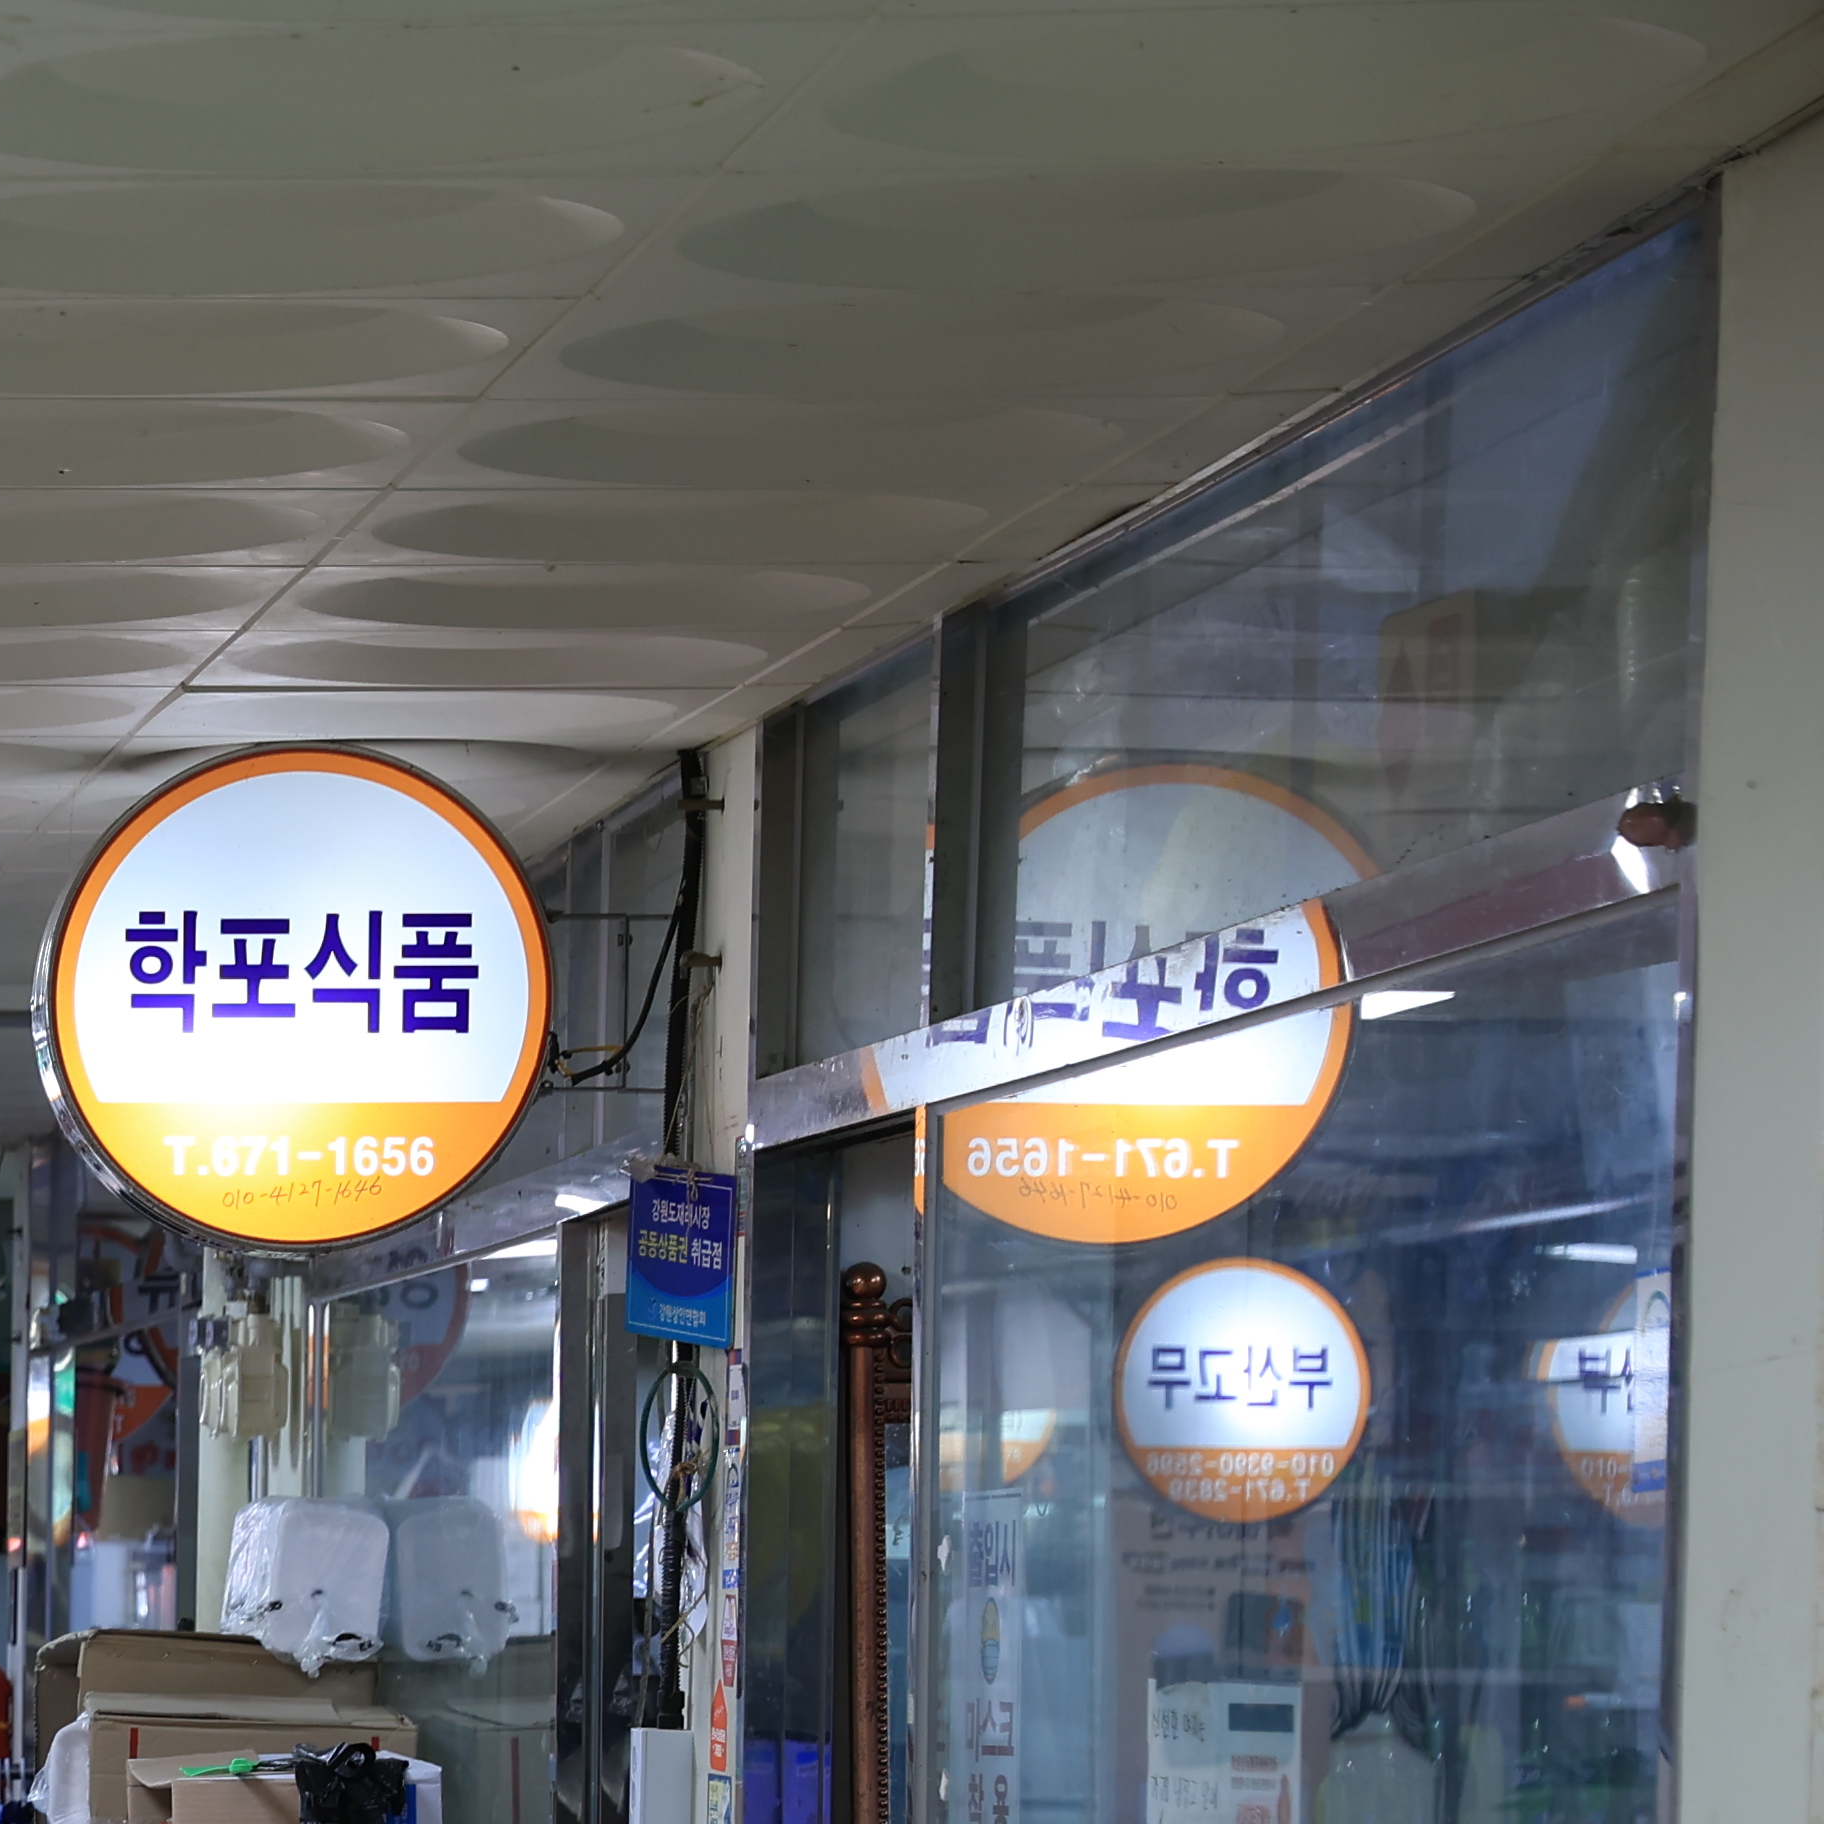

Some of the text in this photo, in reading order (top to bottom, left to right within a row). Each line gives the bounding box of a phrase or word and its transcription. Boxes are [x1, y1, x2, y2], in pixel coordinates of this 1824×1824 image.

[125, 910, 479, 1033] 학포식품
[163, 1135, 435, 1177] T.671-1656
[222, 1176, 384, 1210] 010-4127-1646
[652, 1199, 711, 1230] 강원도재래시장
[638, 1229, 723, 1270] 공동상품권 취급점
[966, 1697, 1014, 1763] 마스크
